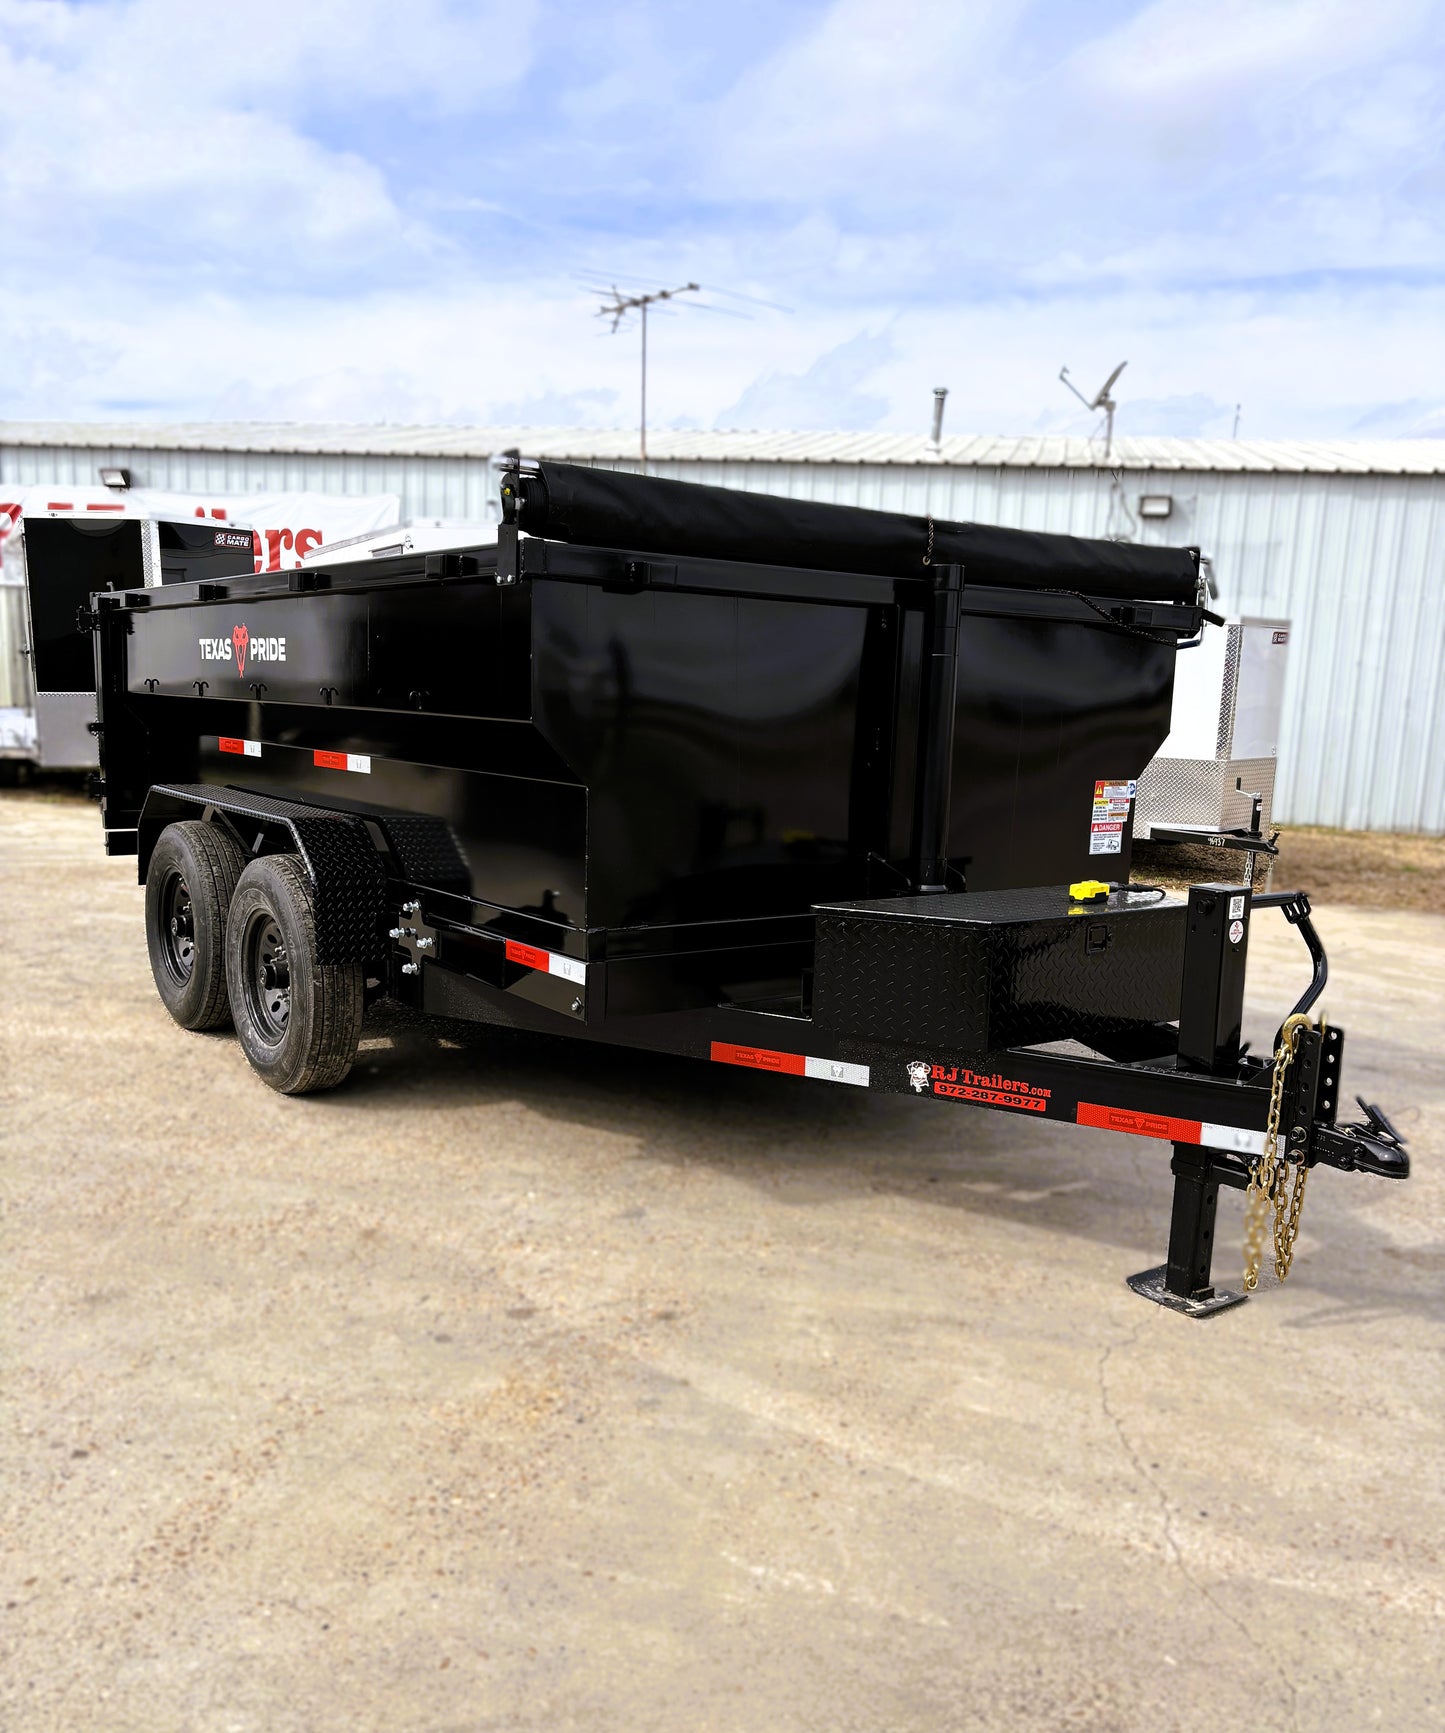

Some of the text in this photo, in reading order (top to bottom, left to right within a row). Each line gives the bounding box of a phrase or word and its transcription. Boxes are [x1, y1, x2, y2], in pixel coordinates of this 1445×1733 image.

[199, 637, 286, 661] TEXAS PRIDE
[930, 1064, 959, 1082] RJ
[938, 1084, 1042, 1109] 972-287-9977
[1110, 1115, 1168, 1130] TEXAS PRIDE
